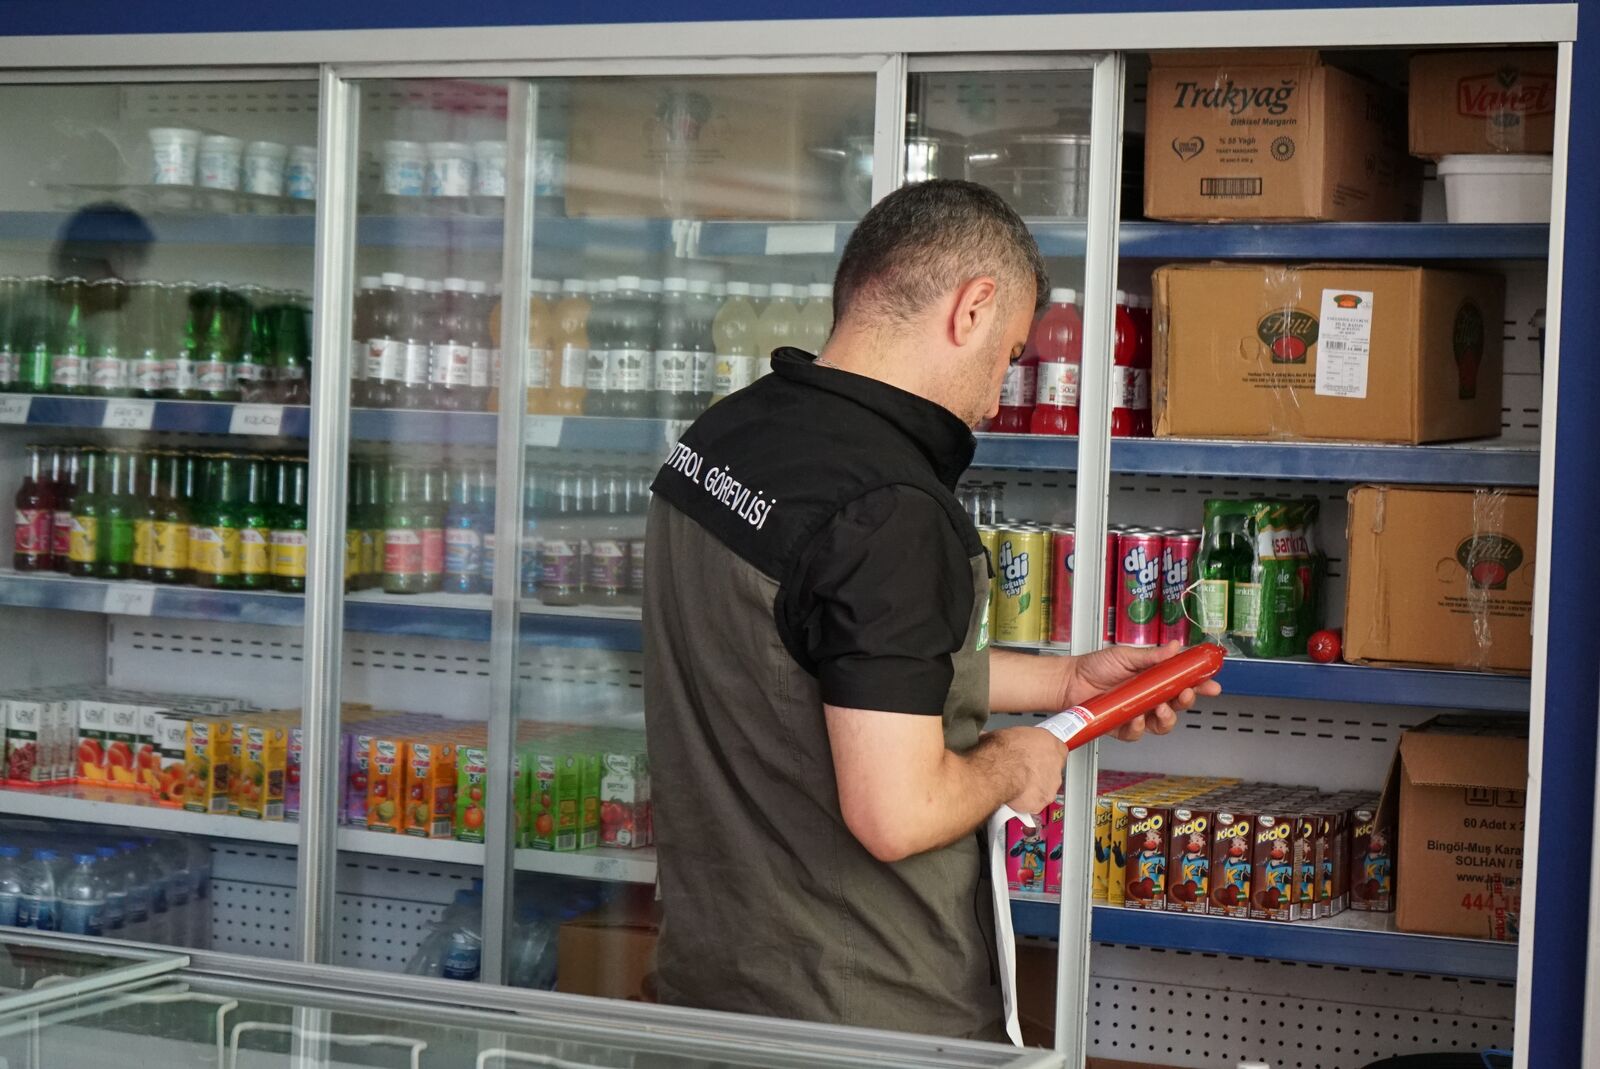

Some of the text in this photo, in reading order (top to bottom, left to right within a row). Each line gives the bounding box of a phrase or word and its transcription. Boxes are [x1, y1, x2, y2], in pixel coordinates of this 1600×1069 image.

[1173, 79, 1296, 115] Trakyağ
[1263, 118, 1297, 127] Margarin
[664, 441, 704, 484] TROL
[1463, 817, 1477, 829] 60
[1479, 818, 1507, 830] Adet
[1495, 844, 1524, 857] Kara
[1455, 855, 1506, 869] SOLHAN
